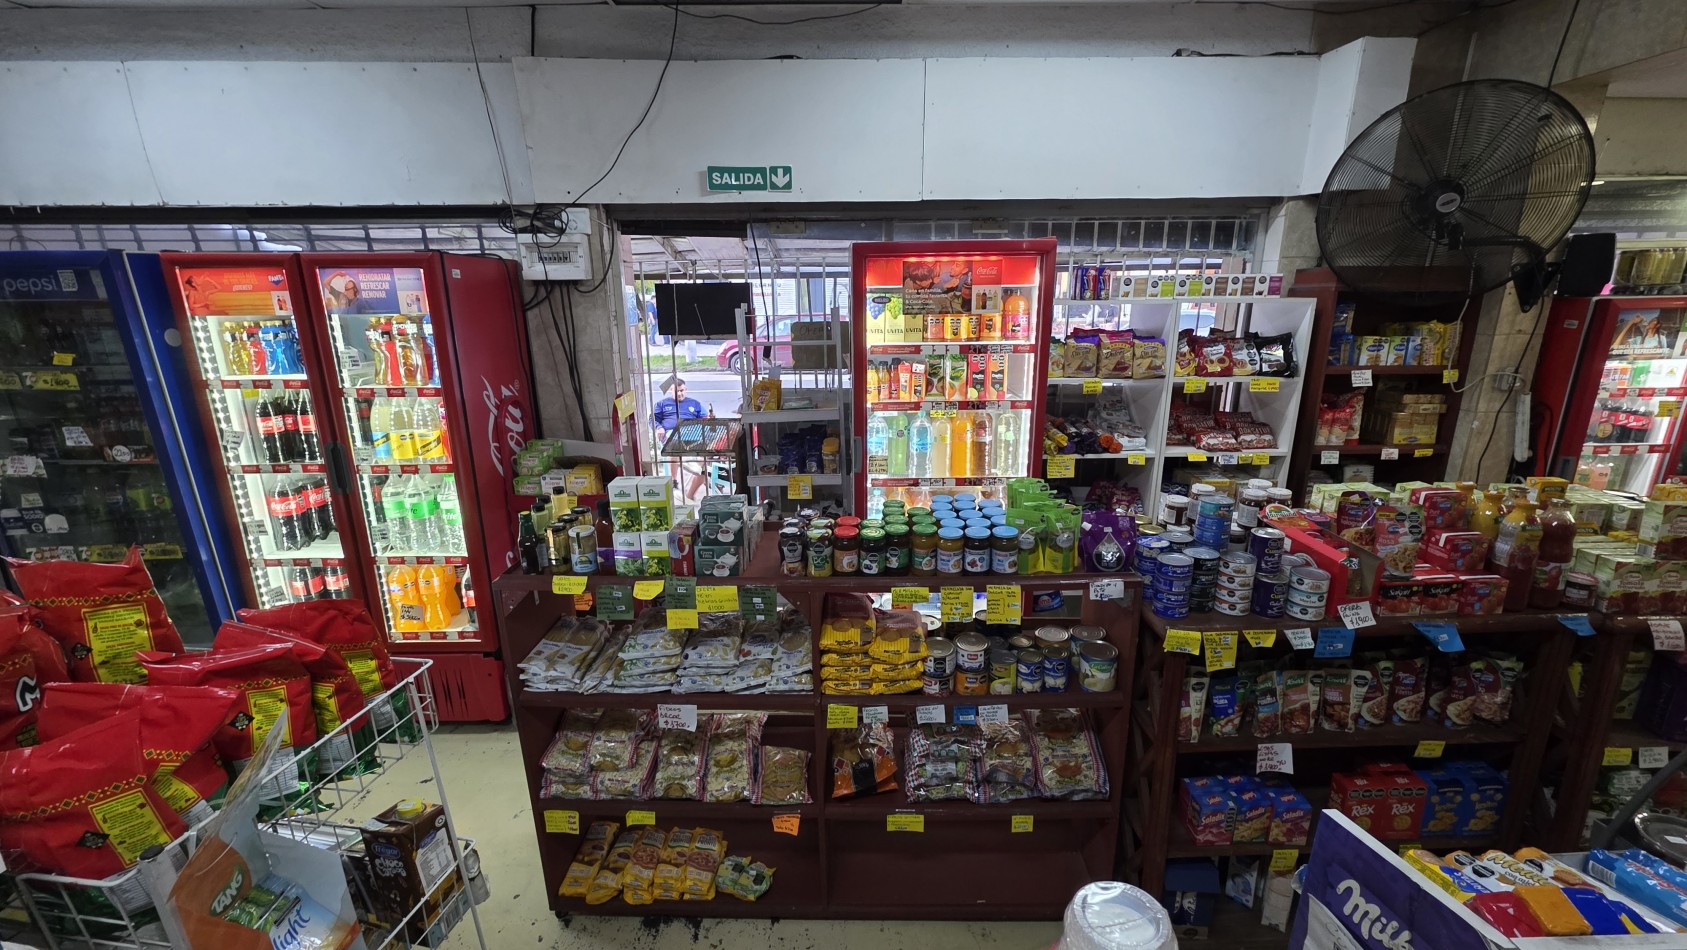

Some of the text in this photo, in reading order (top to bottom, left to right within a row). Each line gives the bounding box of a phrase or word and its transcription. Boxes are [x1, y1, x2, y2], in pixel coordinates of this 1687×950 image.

[712, 172, 764, 186] SALIDA
[358, 273, 392, 281] REHIDRATAR
[3, 274, 58, 295] pepsi
[360, 281, 390, 290] REFRESCAR
[361, 290, 387, 299] RENOVAR
[1202, 813, 1225, 825] Saladix
[375, 846, 398, 855] Trégar
[211, 870, 242, 913] TANG
[273, 905, 311, 950] light
